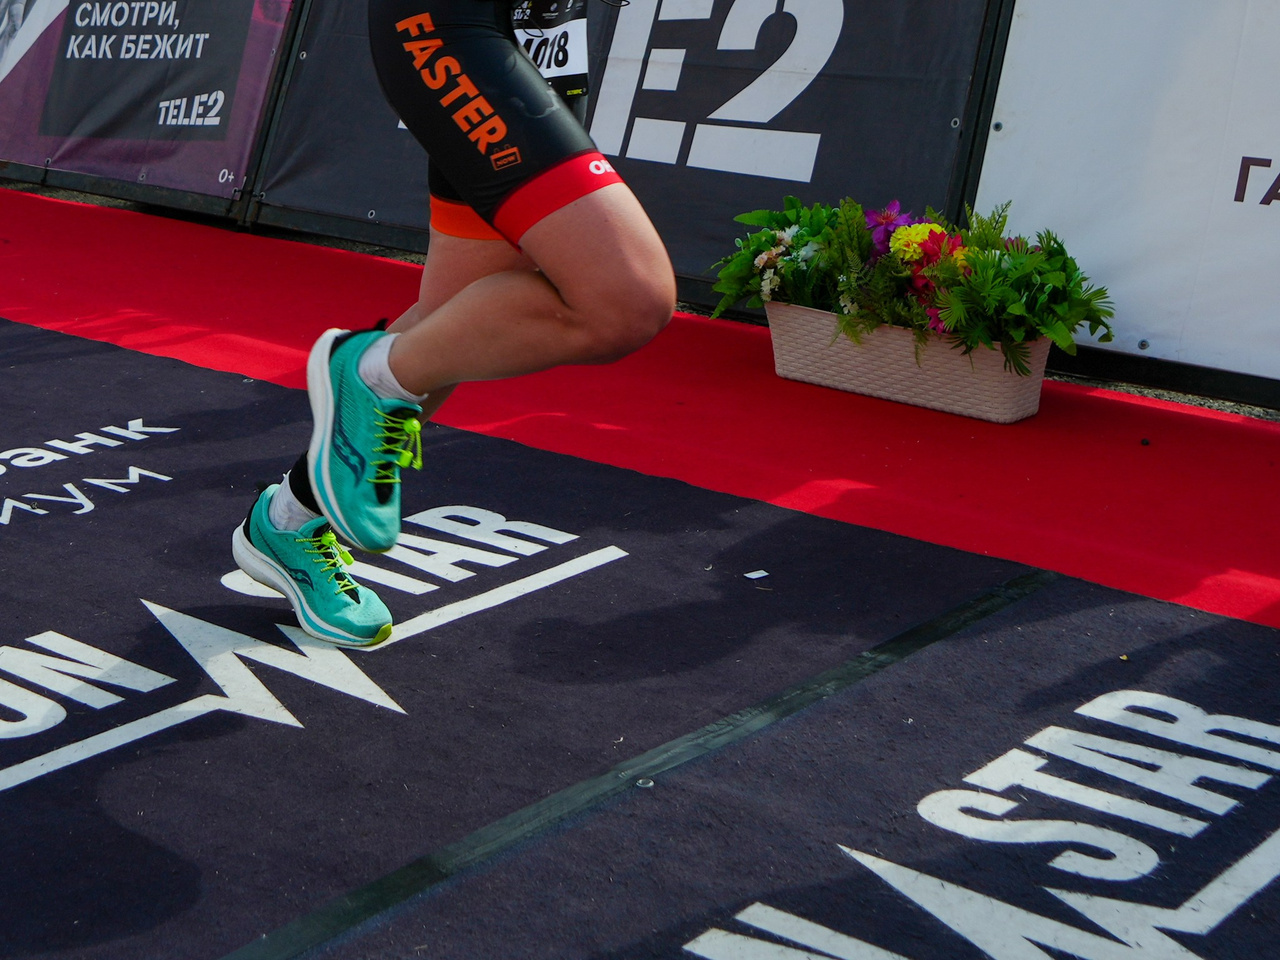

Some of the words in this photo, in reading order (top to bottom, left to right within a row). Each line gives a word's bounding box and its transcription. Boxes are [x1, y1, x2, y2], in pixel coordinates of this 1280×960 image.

[75, 1, 180, 30] СМОТРИ,
[66, 34, 116, 59] КАК
[120, 33, 210, 59] БЕЖИТ
[395, 12, 508, 155] FASTER
[158, 90, 225, 125] TELE2
